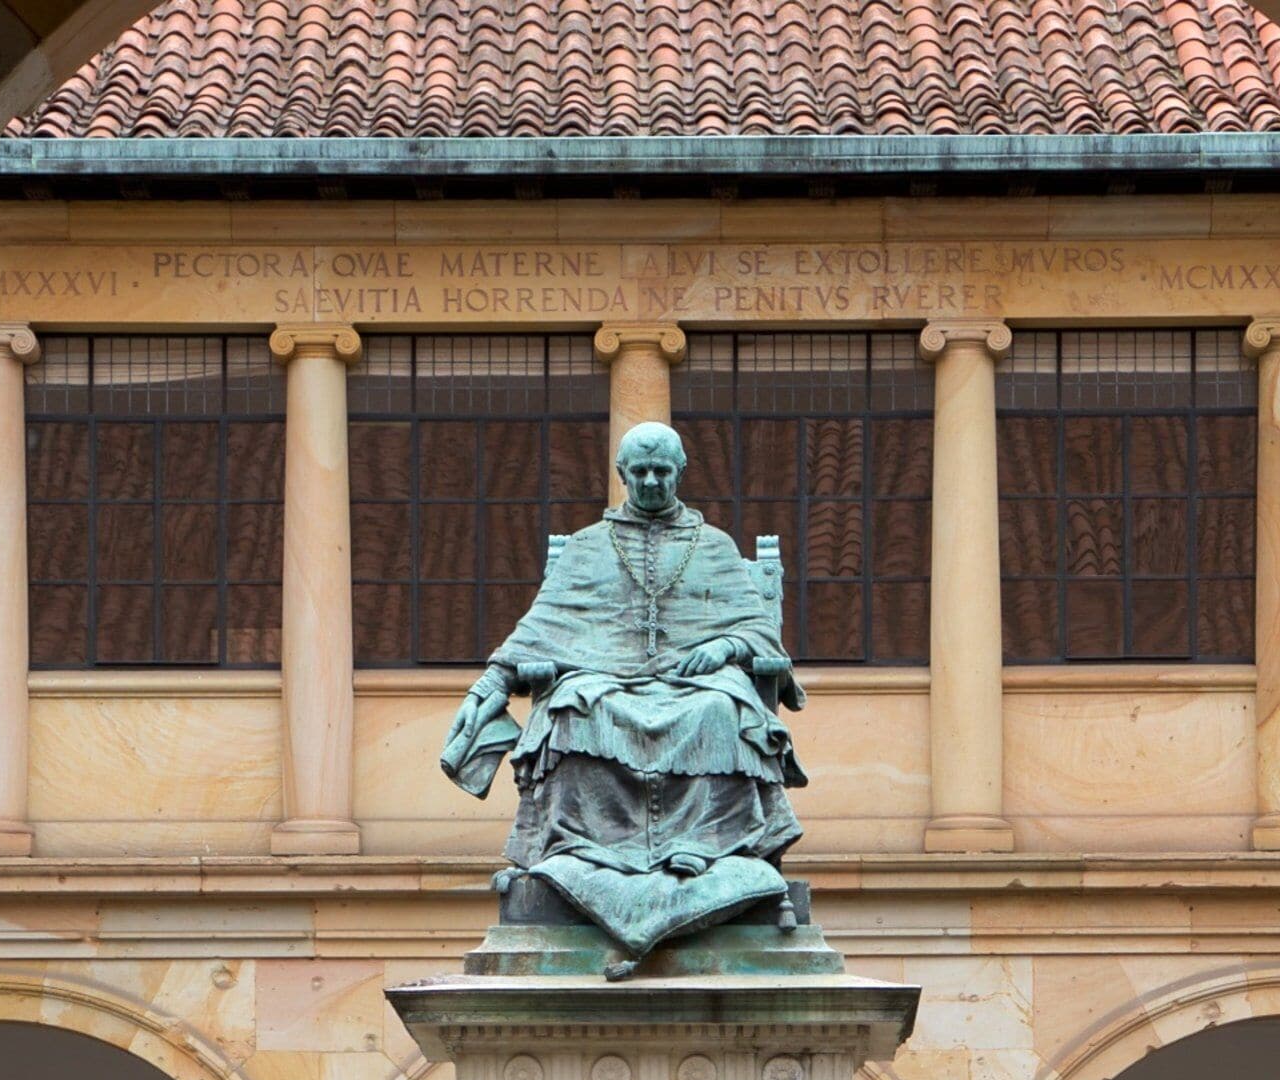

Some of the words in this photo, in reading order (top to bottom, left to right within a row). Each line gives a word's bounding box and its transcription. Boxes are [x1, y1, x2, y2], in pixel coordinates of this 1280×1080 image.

[153, 251, 310, 279] PECTORA
[331, 251, 414, 279] QVAE
[439, 250, 604, 278] MATERNE
[737, 250, 772, 276] SE
[795, 248, 993, 276] EXTOLLERE
[1010, 247, 1126, 274] MVROS
[275, 286, 422, 314] SAEVITIA
[442, 285, 629, 313] HORRENDA
[714, 285, 851, 312] PENITVS
[871, 284, 1004, 311] RVERER
